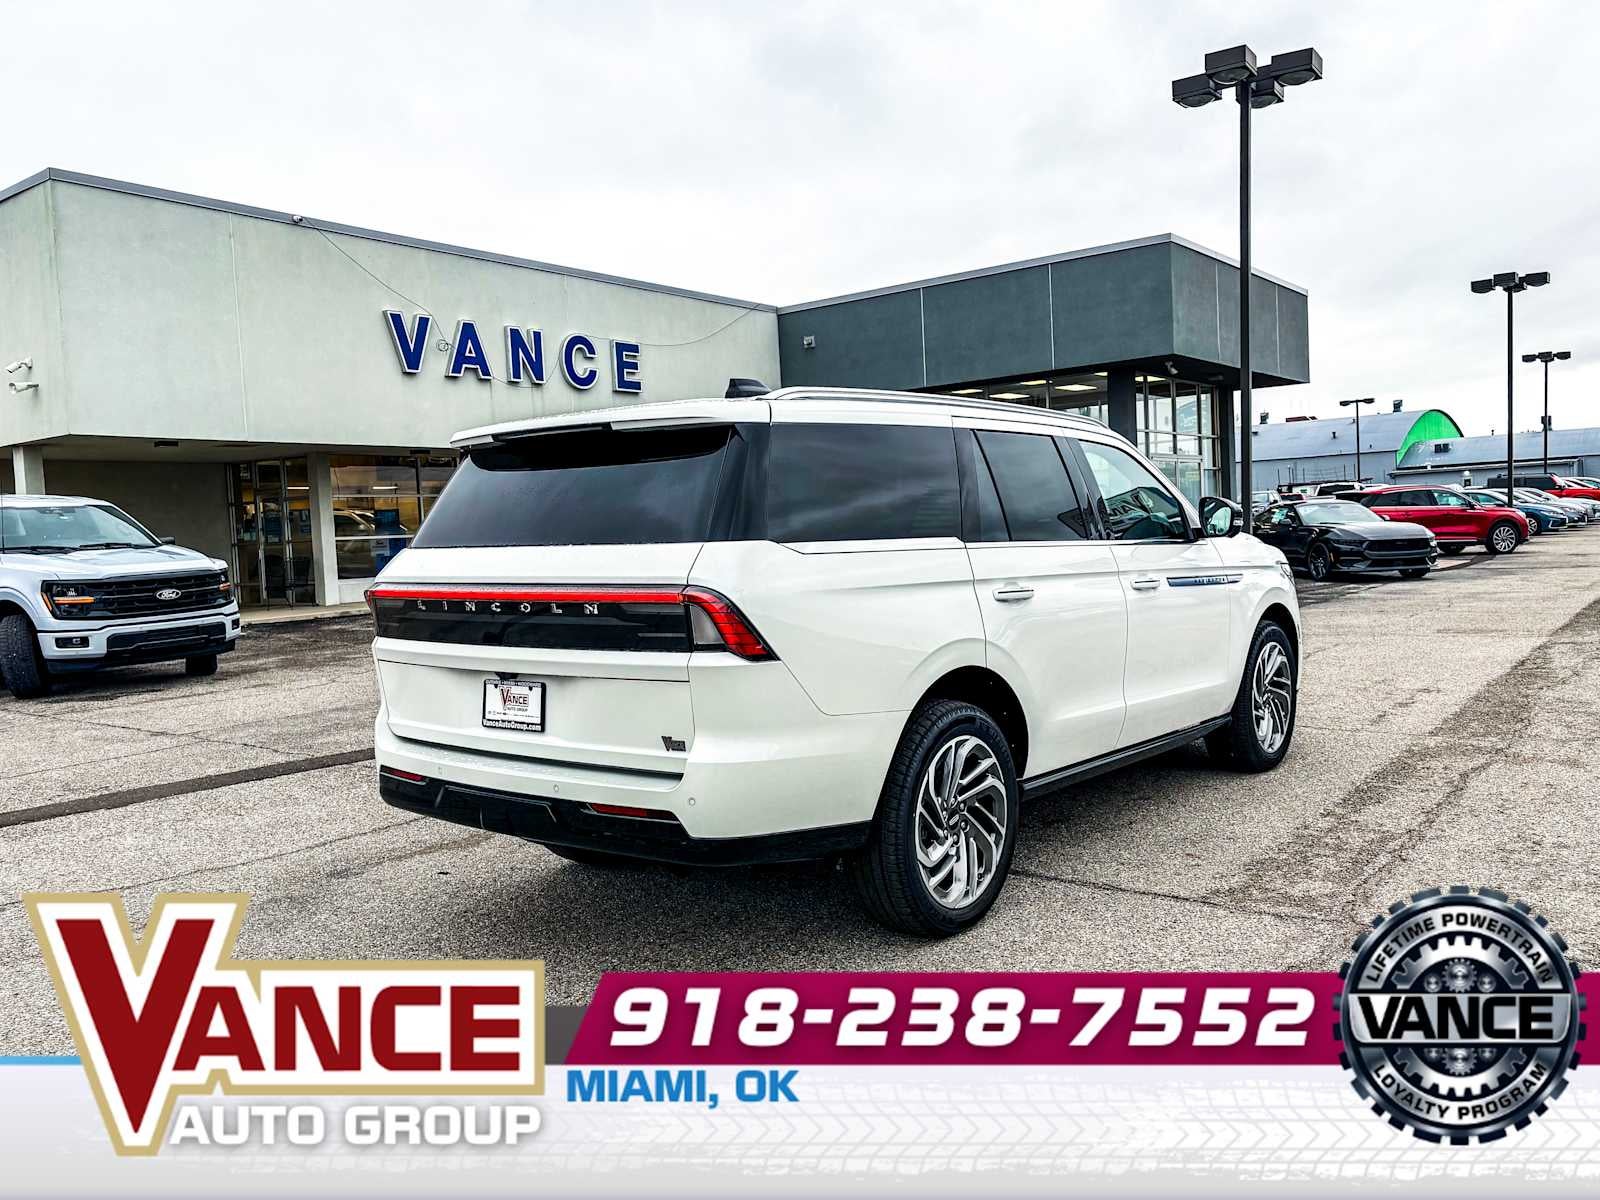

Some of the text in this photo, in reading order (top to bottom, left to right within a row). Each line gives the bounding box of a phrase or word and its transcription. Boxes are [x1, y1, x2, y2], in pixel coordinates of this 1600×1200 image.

[383, 310, 642, 393] VANCE
[416, 599, 599, 615] LINCOLN
[500, 688, 528, 705] VANCE
[483, 720, 541, 731] VanceAutoGroup.com
